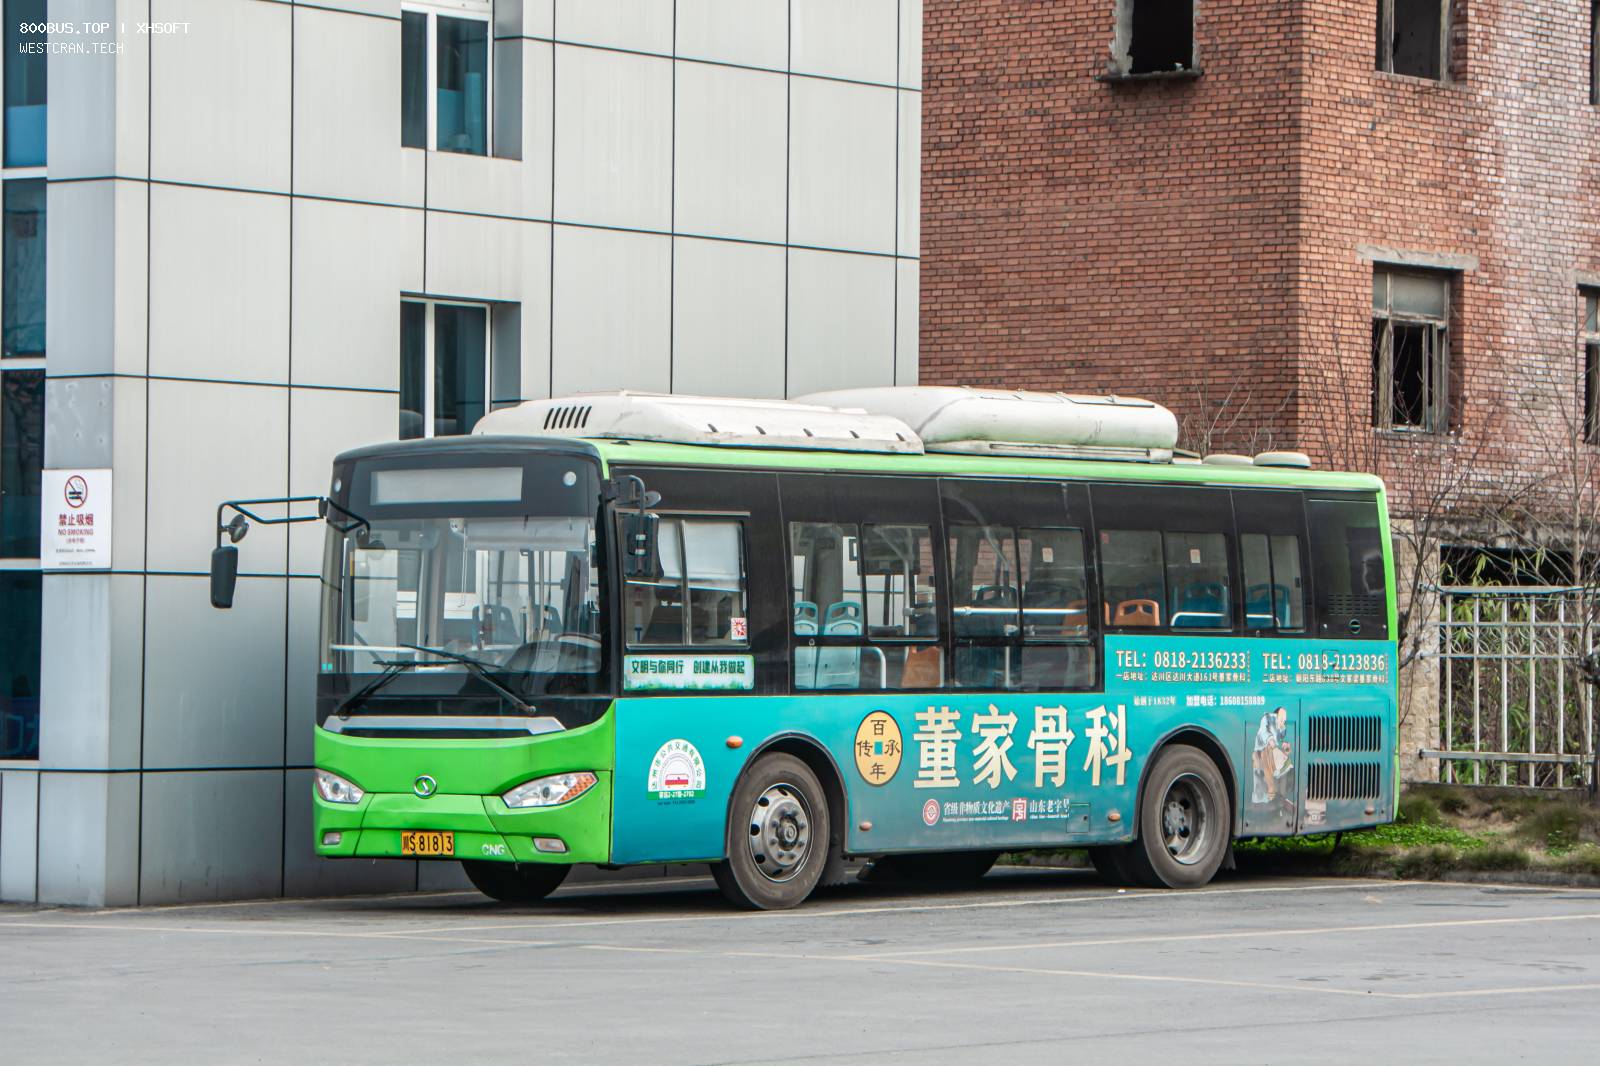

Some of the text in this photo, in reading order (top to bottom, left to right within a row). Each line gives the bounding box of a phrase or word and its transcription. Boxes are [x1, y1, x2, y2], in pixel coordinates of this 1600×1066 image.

[58, 513, 94, 527] 禁止吸烟
[58, 528, 94, 536] NO SMOKING
[631, 659, 746, 674] 文明与你同行 创建从我做起
[1154, 651, 1247, 670] 0818-2136233
[1298, 653, 1385, 672] 0818-2123836
[912, 704, 1132, 789] 董家骨科
[1029, 798, 1070, 813] 山东老字号
[481, 843, 506, 856] CNG
